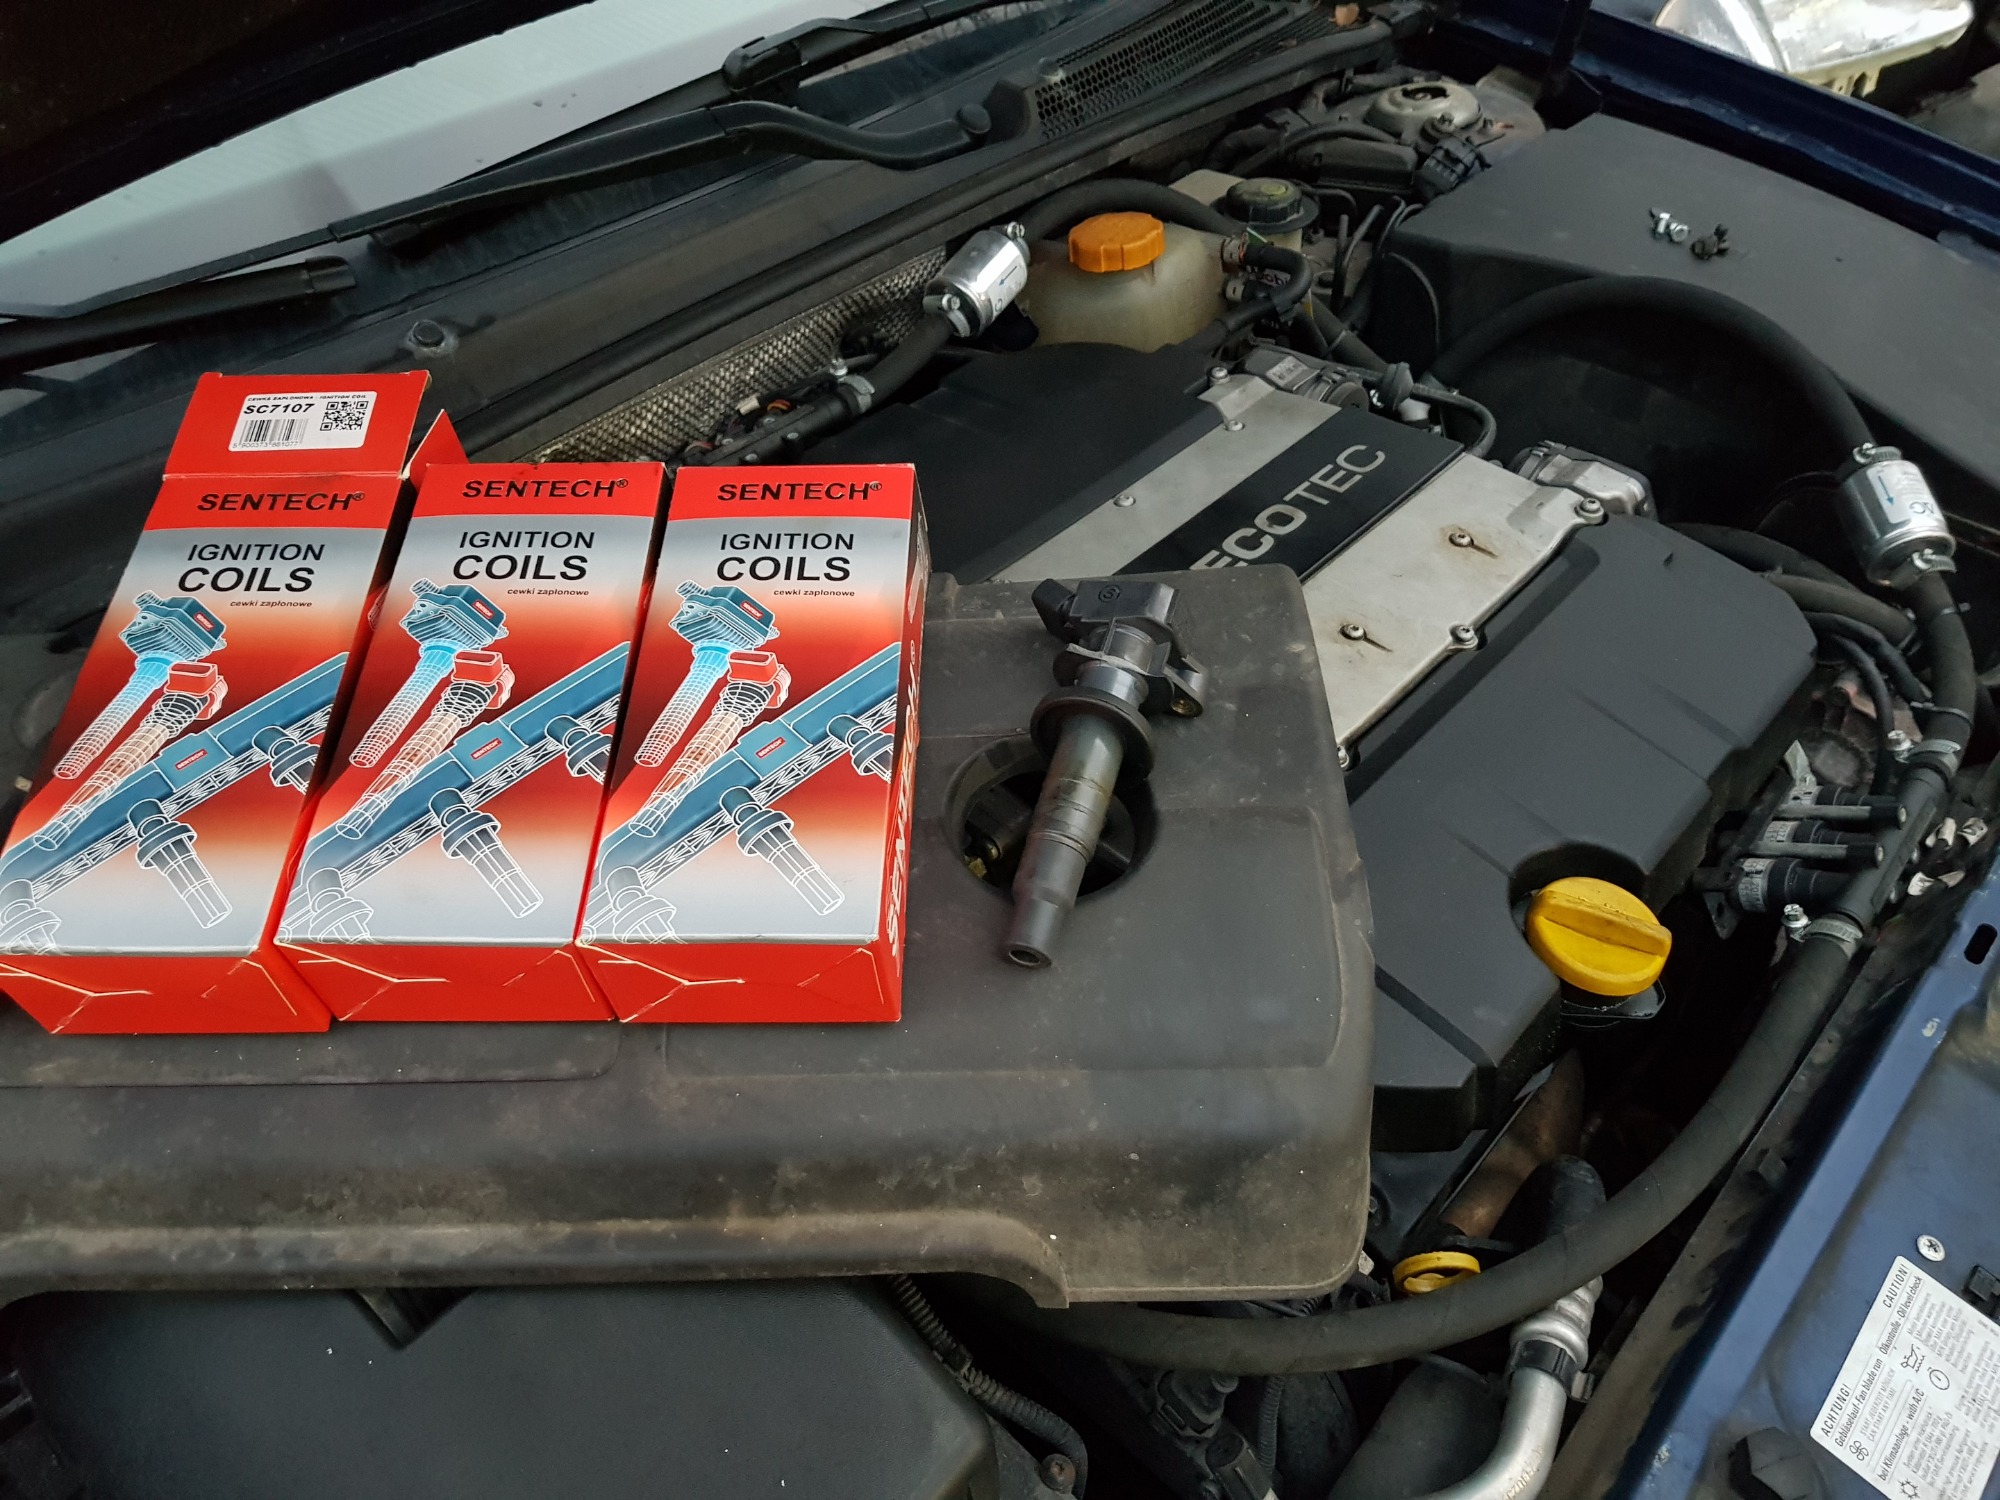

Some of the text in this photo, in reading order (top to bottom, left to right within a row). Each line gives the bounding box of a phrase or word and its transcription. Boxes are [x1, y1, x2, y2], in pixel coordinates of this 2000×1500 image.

[244, 403, 315, 414] SC7107
[188, 544, 325, 561] IGNITION
[459, 531, 595, 549] IGNITION
[720, 533, 854, 550] IGNITION
[178, 567, 315, 592] COILS
[453, 555, 588, 580] COILS
[717, 556, 851, 582] COILS
[1882, 1264, 1908, 1308] CAUTION!
[1901, 1292, 1914, 1310] level
[1909, 1276, 1922, 1295] check
[1861, 1371, 1877, 1391] blade
[1873, 1358, 1883, 1372] run
[1821, 1384, 1850, 1437] ACHTUNG!
[1906, 1404, 1918, 1420] with
